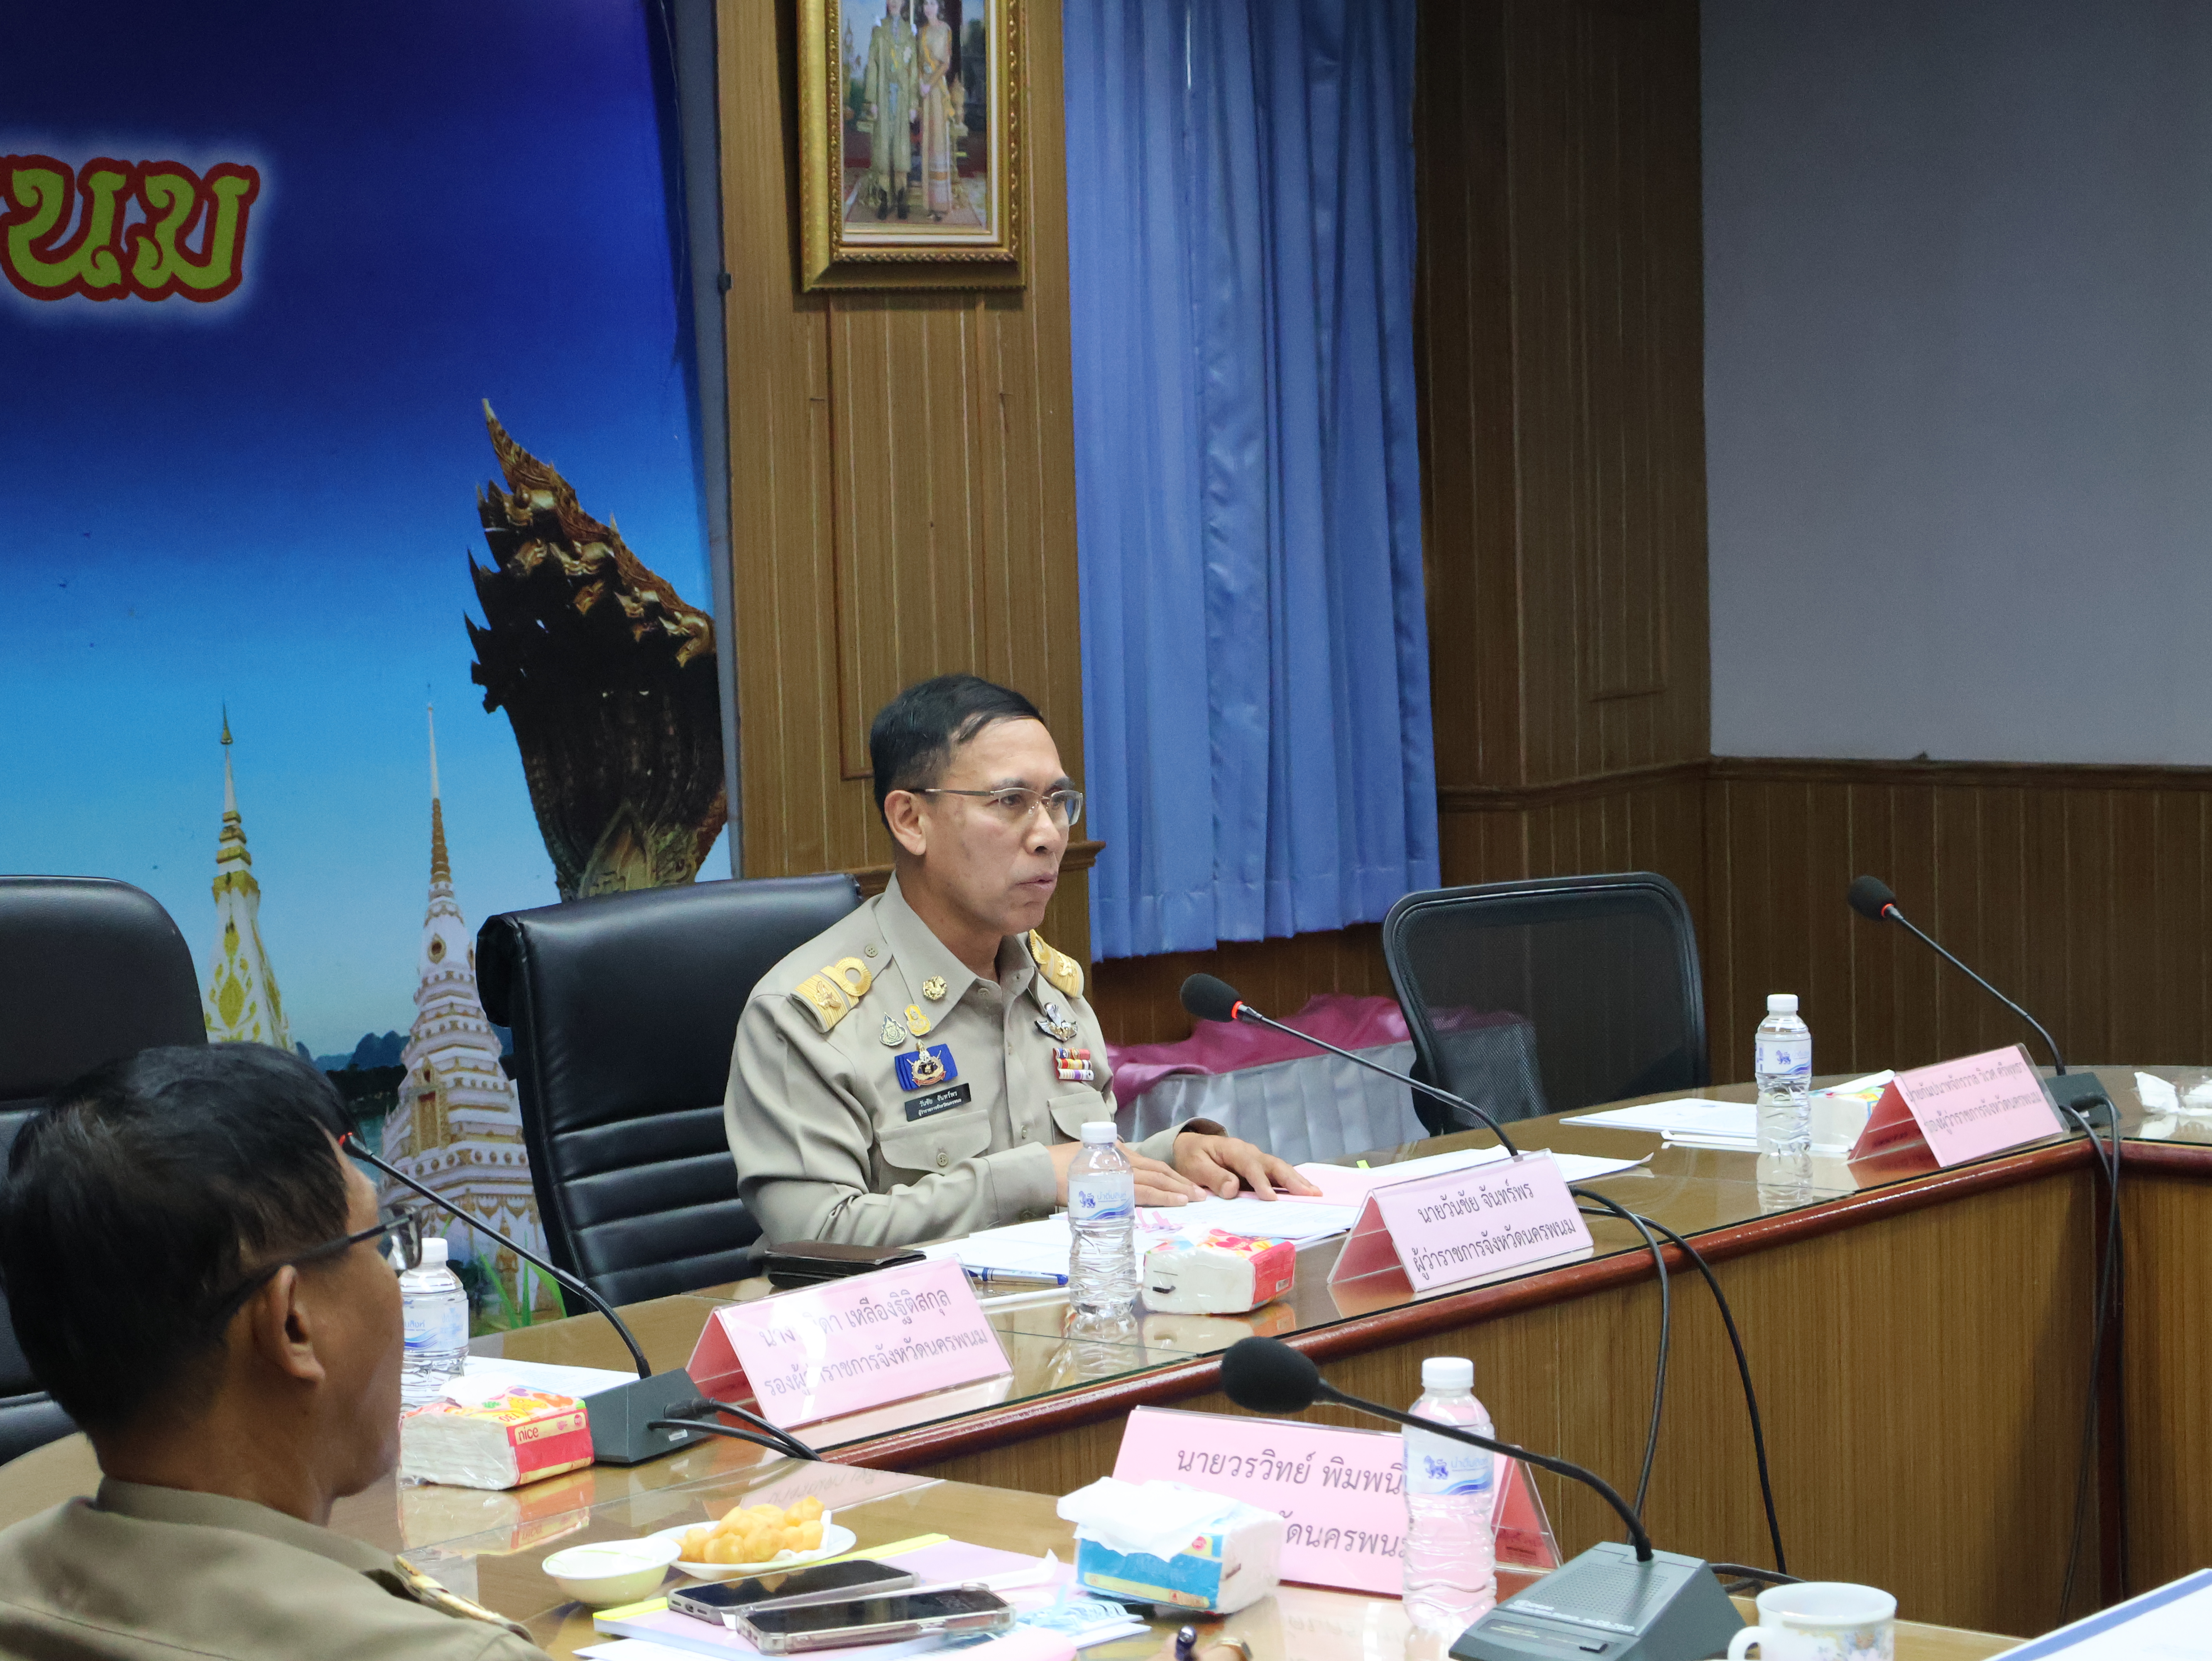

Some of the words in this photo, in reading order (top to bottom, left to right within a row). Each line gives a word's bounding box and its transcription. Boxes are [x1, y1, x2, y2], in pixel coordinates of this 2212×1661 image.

[0, 154, 260, 302] นม
[1418, 1190, 1479, 1224] นายวันชัย
[1479, 1179, 1534, 1208] จันทร์พร
[1412, 1218, 1577, 1280] ผู้ว่าราชการจังหวัดนครพนม
[845, 1289, 952, 1328] เหลืองฐิติสกุล
[518, 1426, 539, 1441] nice
[1178, 1449, 1316, 1484] นายวรวิทย์
[1323, 1456, 1403, 1494] พิมพนิ
[1279, 1510, 1408, 1558] ัดนครพน
